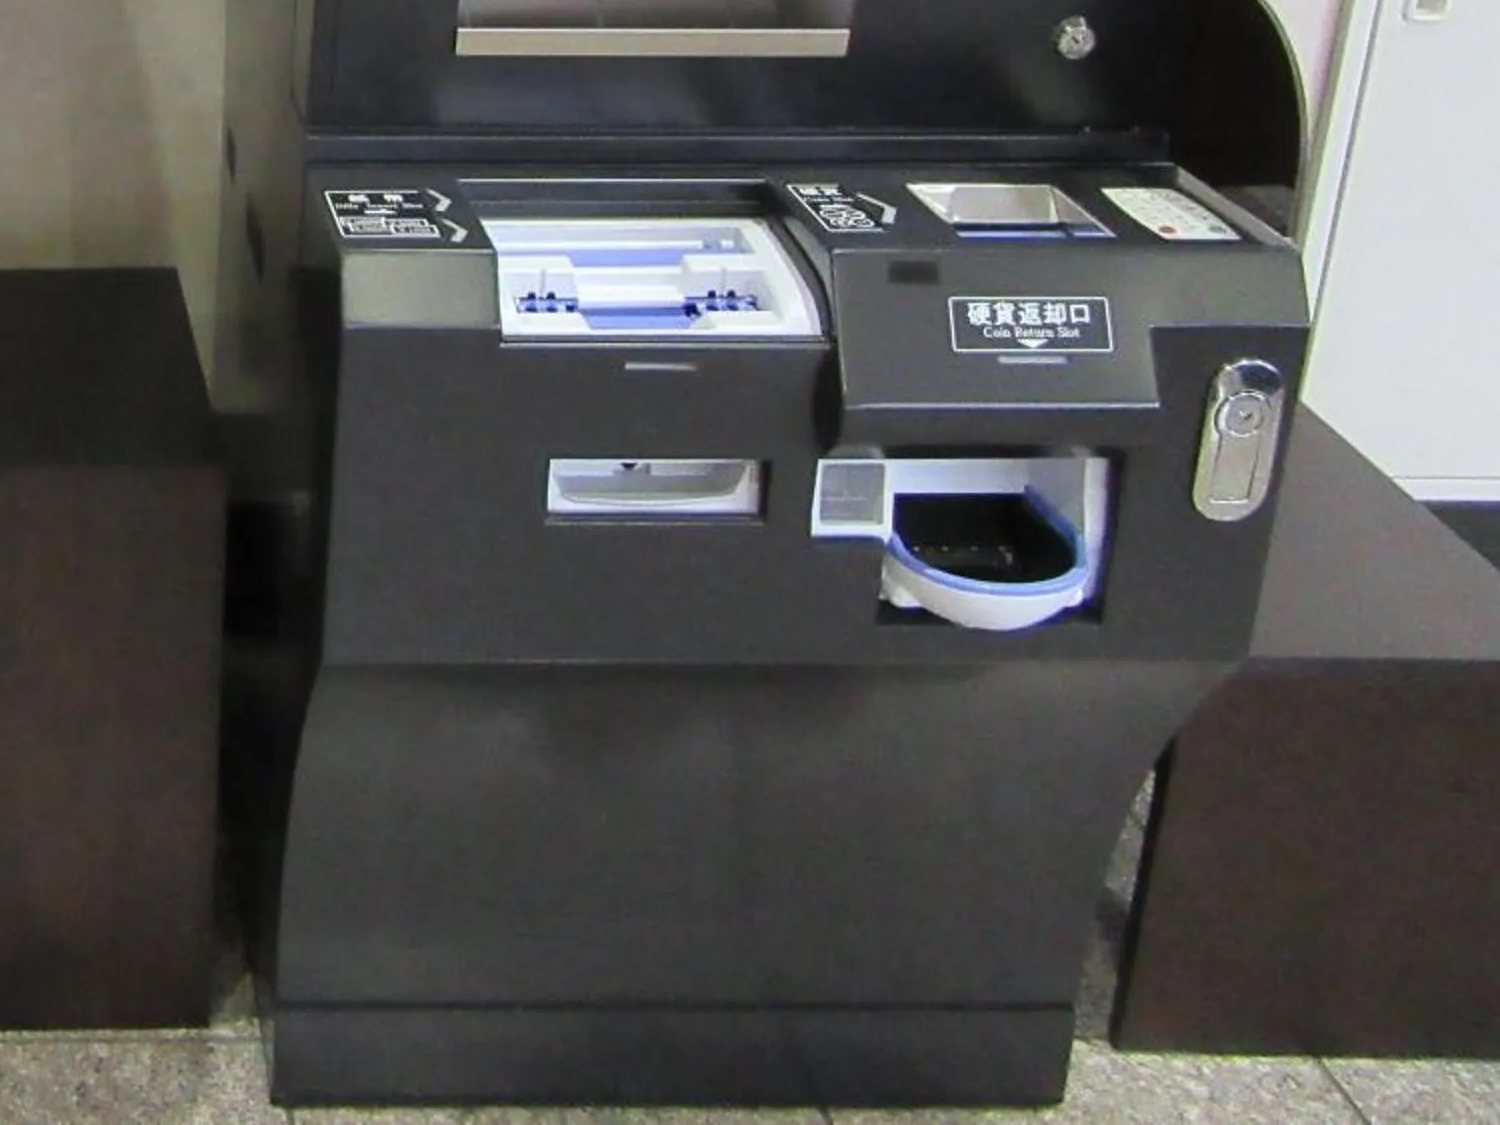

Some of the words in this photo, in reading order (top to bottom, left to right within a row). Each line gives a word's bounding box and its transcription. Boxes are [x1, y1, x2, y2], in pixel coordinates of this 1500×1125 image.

[967, 301, 1091, 325] 硬貨返却口
[983, 326, 1011, 338] Coin
[1014, 326, 1055, 338] Return
[1056, 326, 1081, 338] Slot
